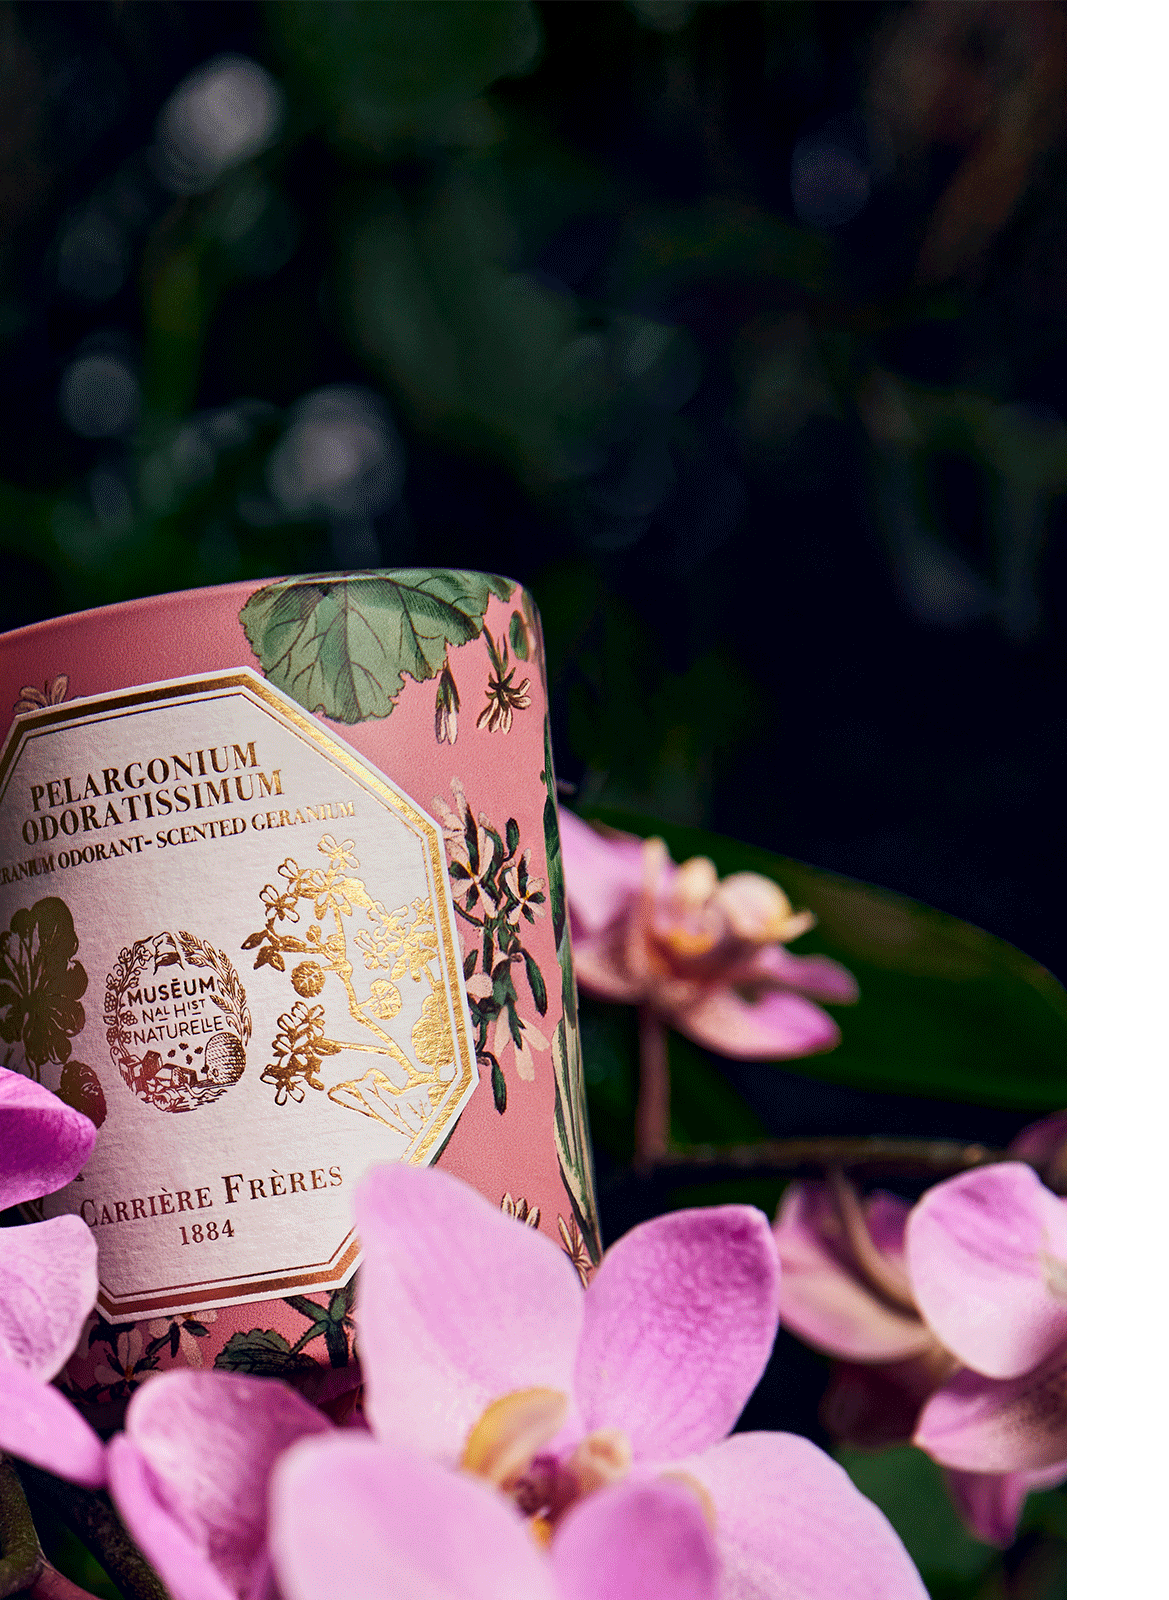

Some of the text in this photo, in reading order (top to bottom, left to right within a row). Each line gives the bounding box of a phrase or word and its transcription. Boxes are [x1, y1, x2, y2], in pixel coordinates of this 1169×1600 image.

[30, 741, 261, 813] PELARGONIUM
[21, 769, 285, 846] ODORATISSIMUM
[156, 817, 247, 848] SCENTED
[251, 802, 356, 832] GERANIUM
[133, 1015, 224, 1046] NATURELLE
[179, 1219, 235, 1246] 1884
